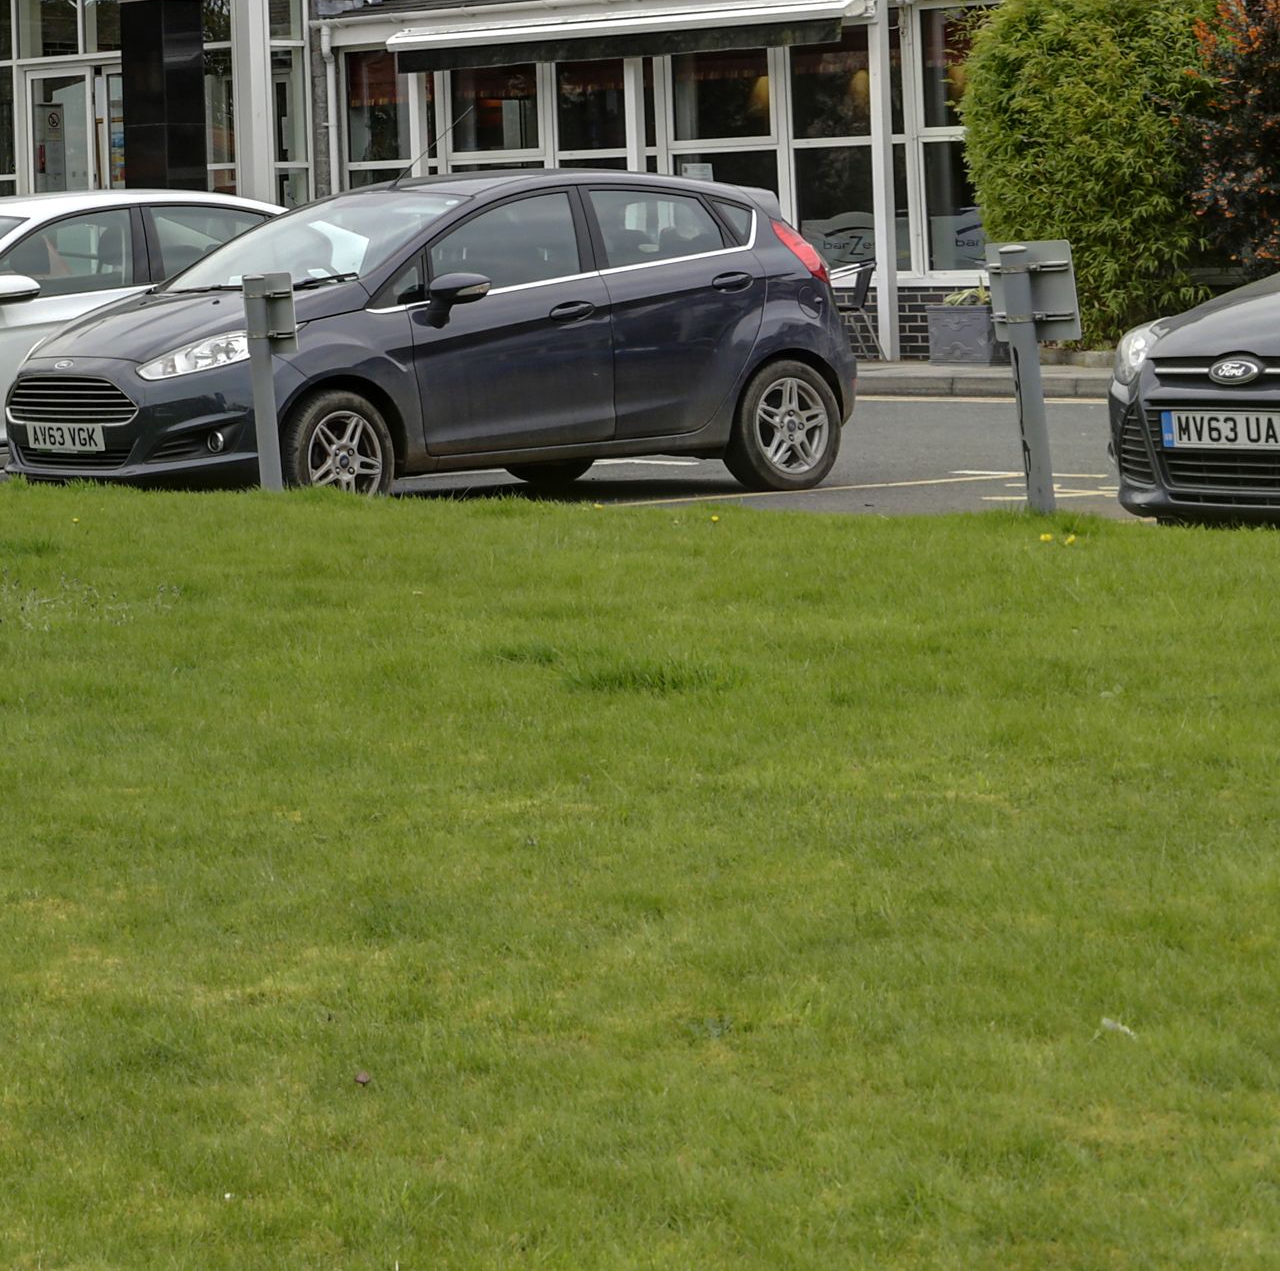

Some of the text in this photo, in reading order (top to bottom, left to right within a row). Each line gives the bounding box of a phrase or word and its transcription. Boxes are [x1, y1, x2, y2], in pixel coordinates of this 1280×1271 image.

[1218, 362, 1246, 377] Ford
[33, 425, 98, 448] AV63 VGK
[1177, 416, 1239, 443] MV63
